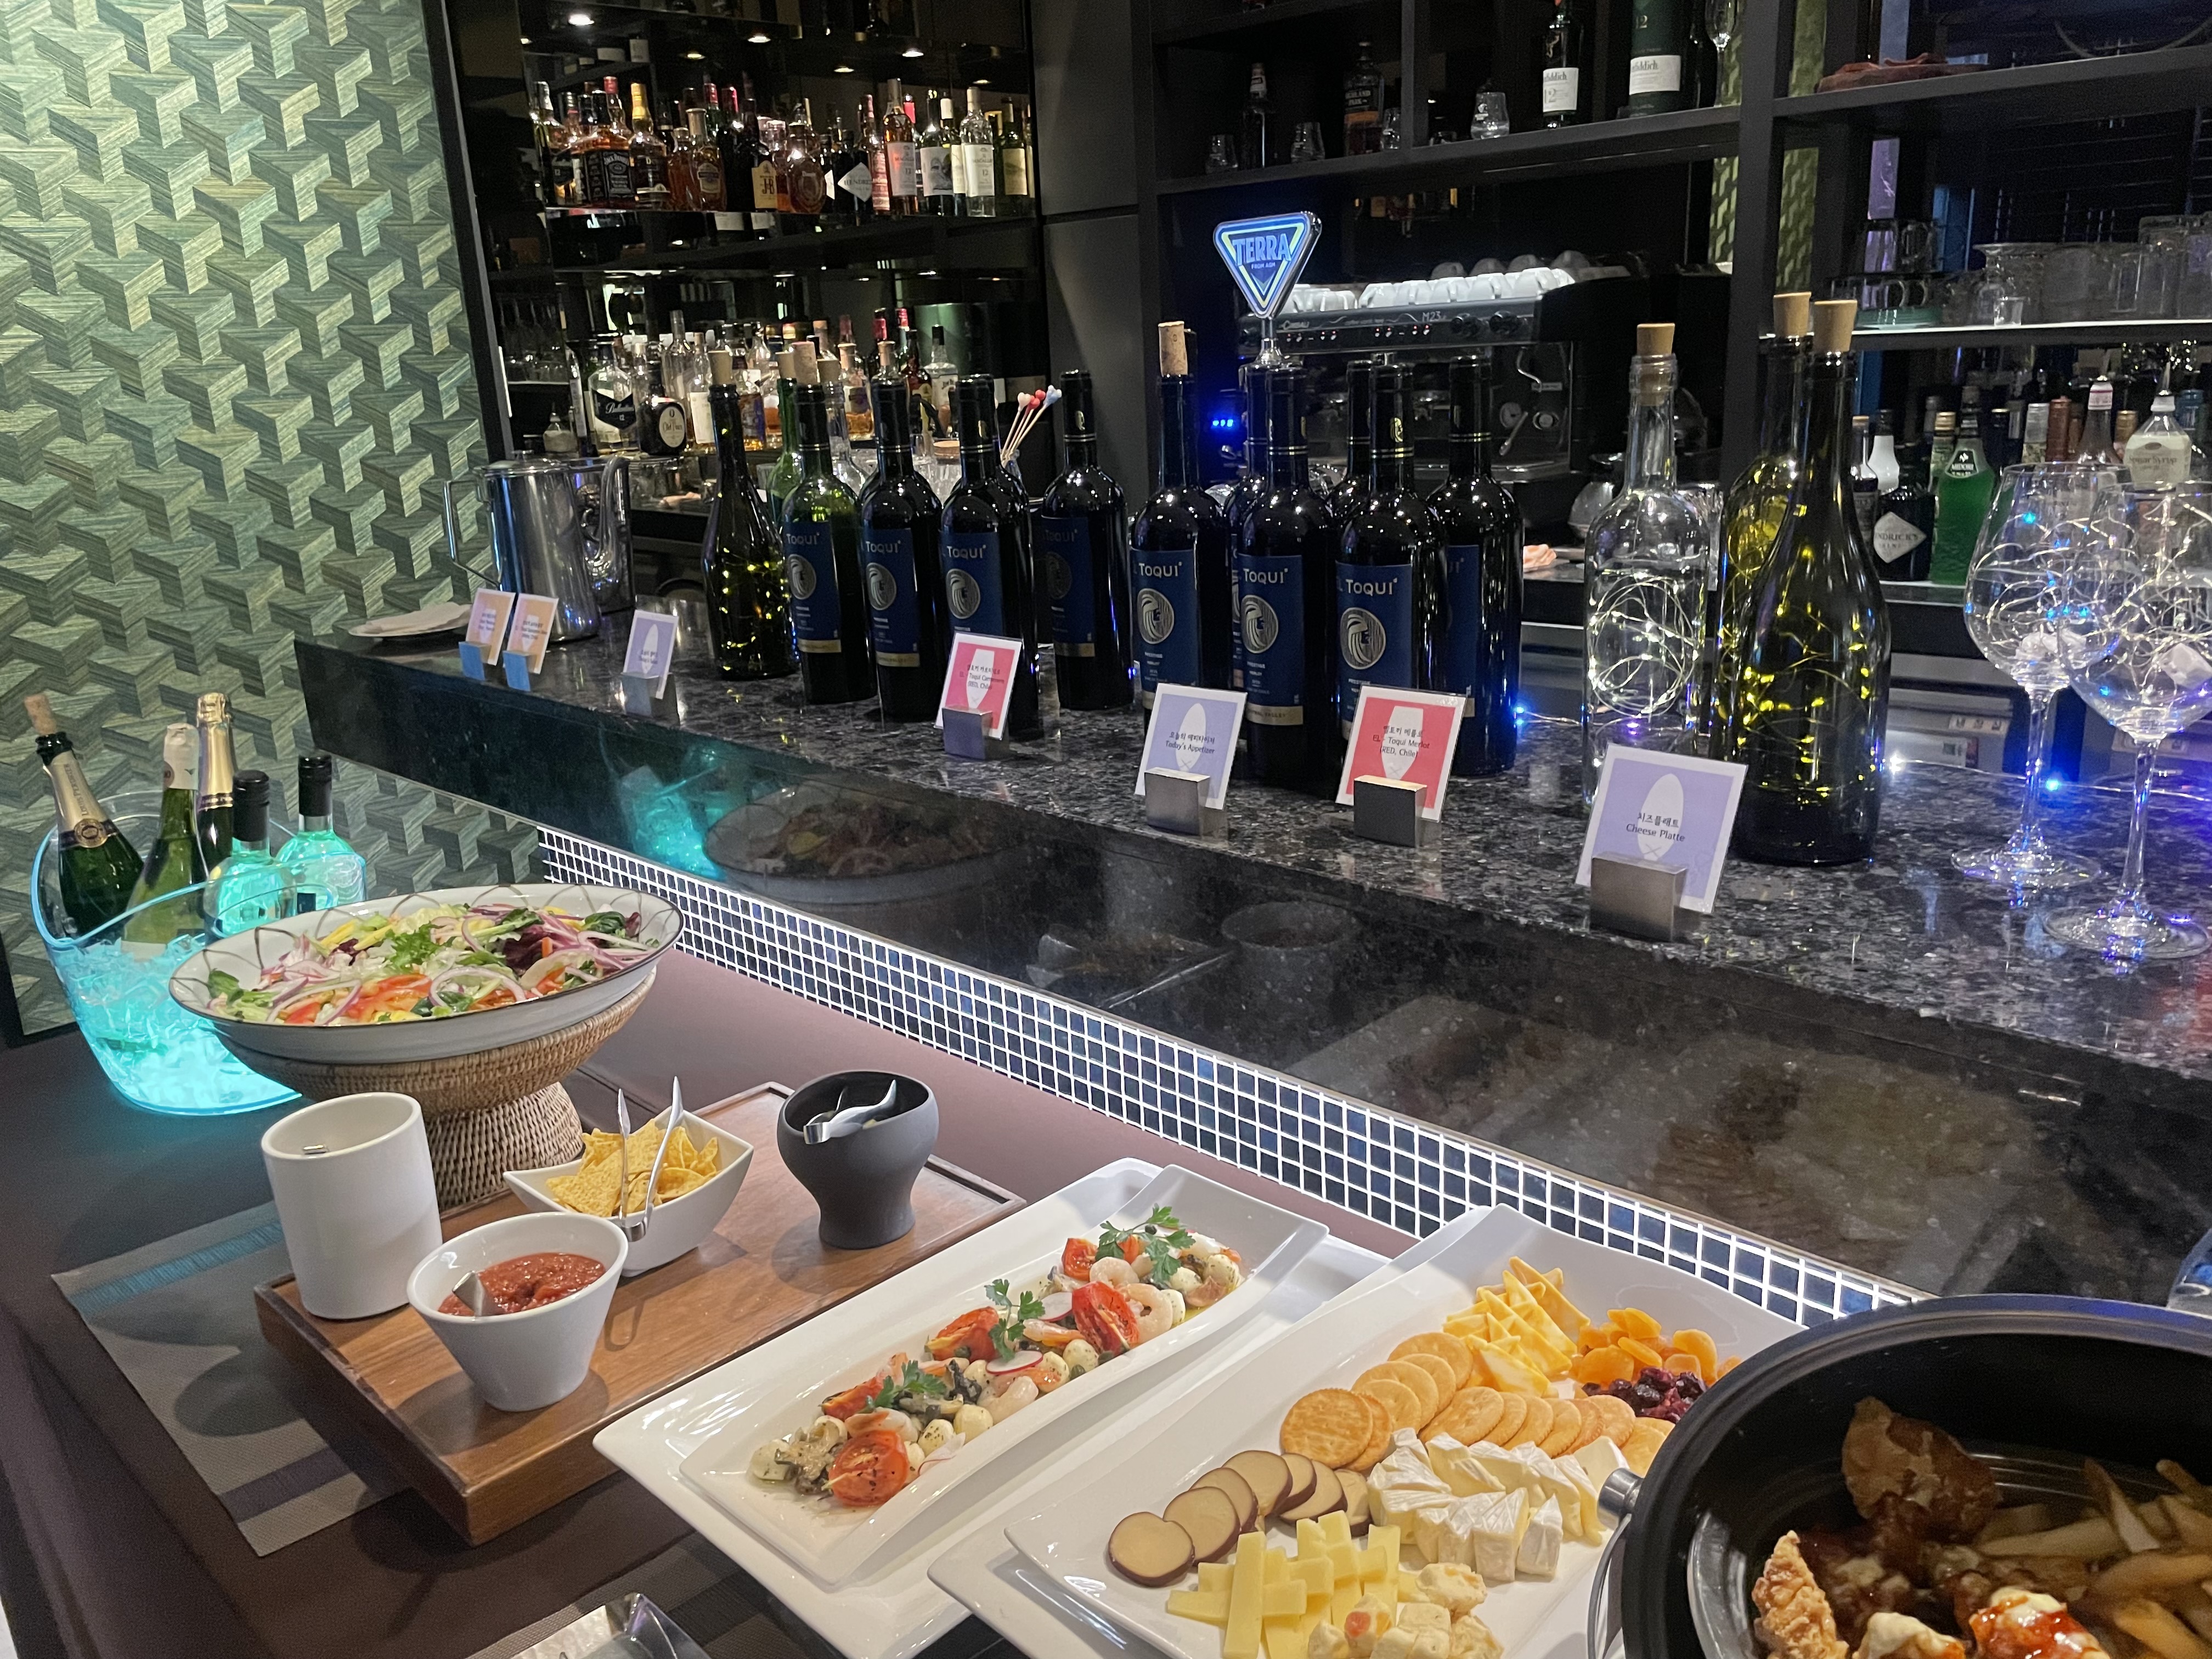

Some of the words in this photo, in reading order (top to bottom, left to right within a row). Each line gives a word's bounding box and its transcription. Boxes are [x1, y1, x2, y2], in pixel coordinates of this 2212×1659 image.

[1232, 233, 1291, 266] TERRA
[2153, 455, 2177, 466] Syrup
[786, 533, 817, 545] TOQUI
[866, 541, 899, 554] TOQUI
[946, 546, 983, 559] TOQUI
[1138, 563, 1178, 579] TOQUI
[1243, 568, 1284, 584] TOQUI
[1346, 579, 1393, 596] TOQUI
[969, 673, 981, 681] Toqui
[1166, 740, 1186, 751] Today's
[1187, 744, 1215, 754] Appetizer
[1389, 736, 1407, 746] Toqui
[1408, 739, 1430, 749] Merlot
[1380, 744, 1397, 755] (RED,
[1399, 748, 1418, 758] Chile)
[1626, 823, 1657, 837] Cheese
[1660, 829, 1686, 842] Platte
